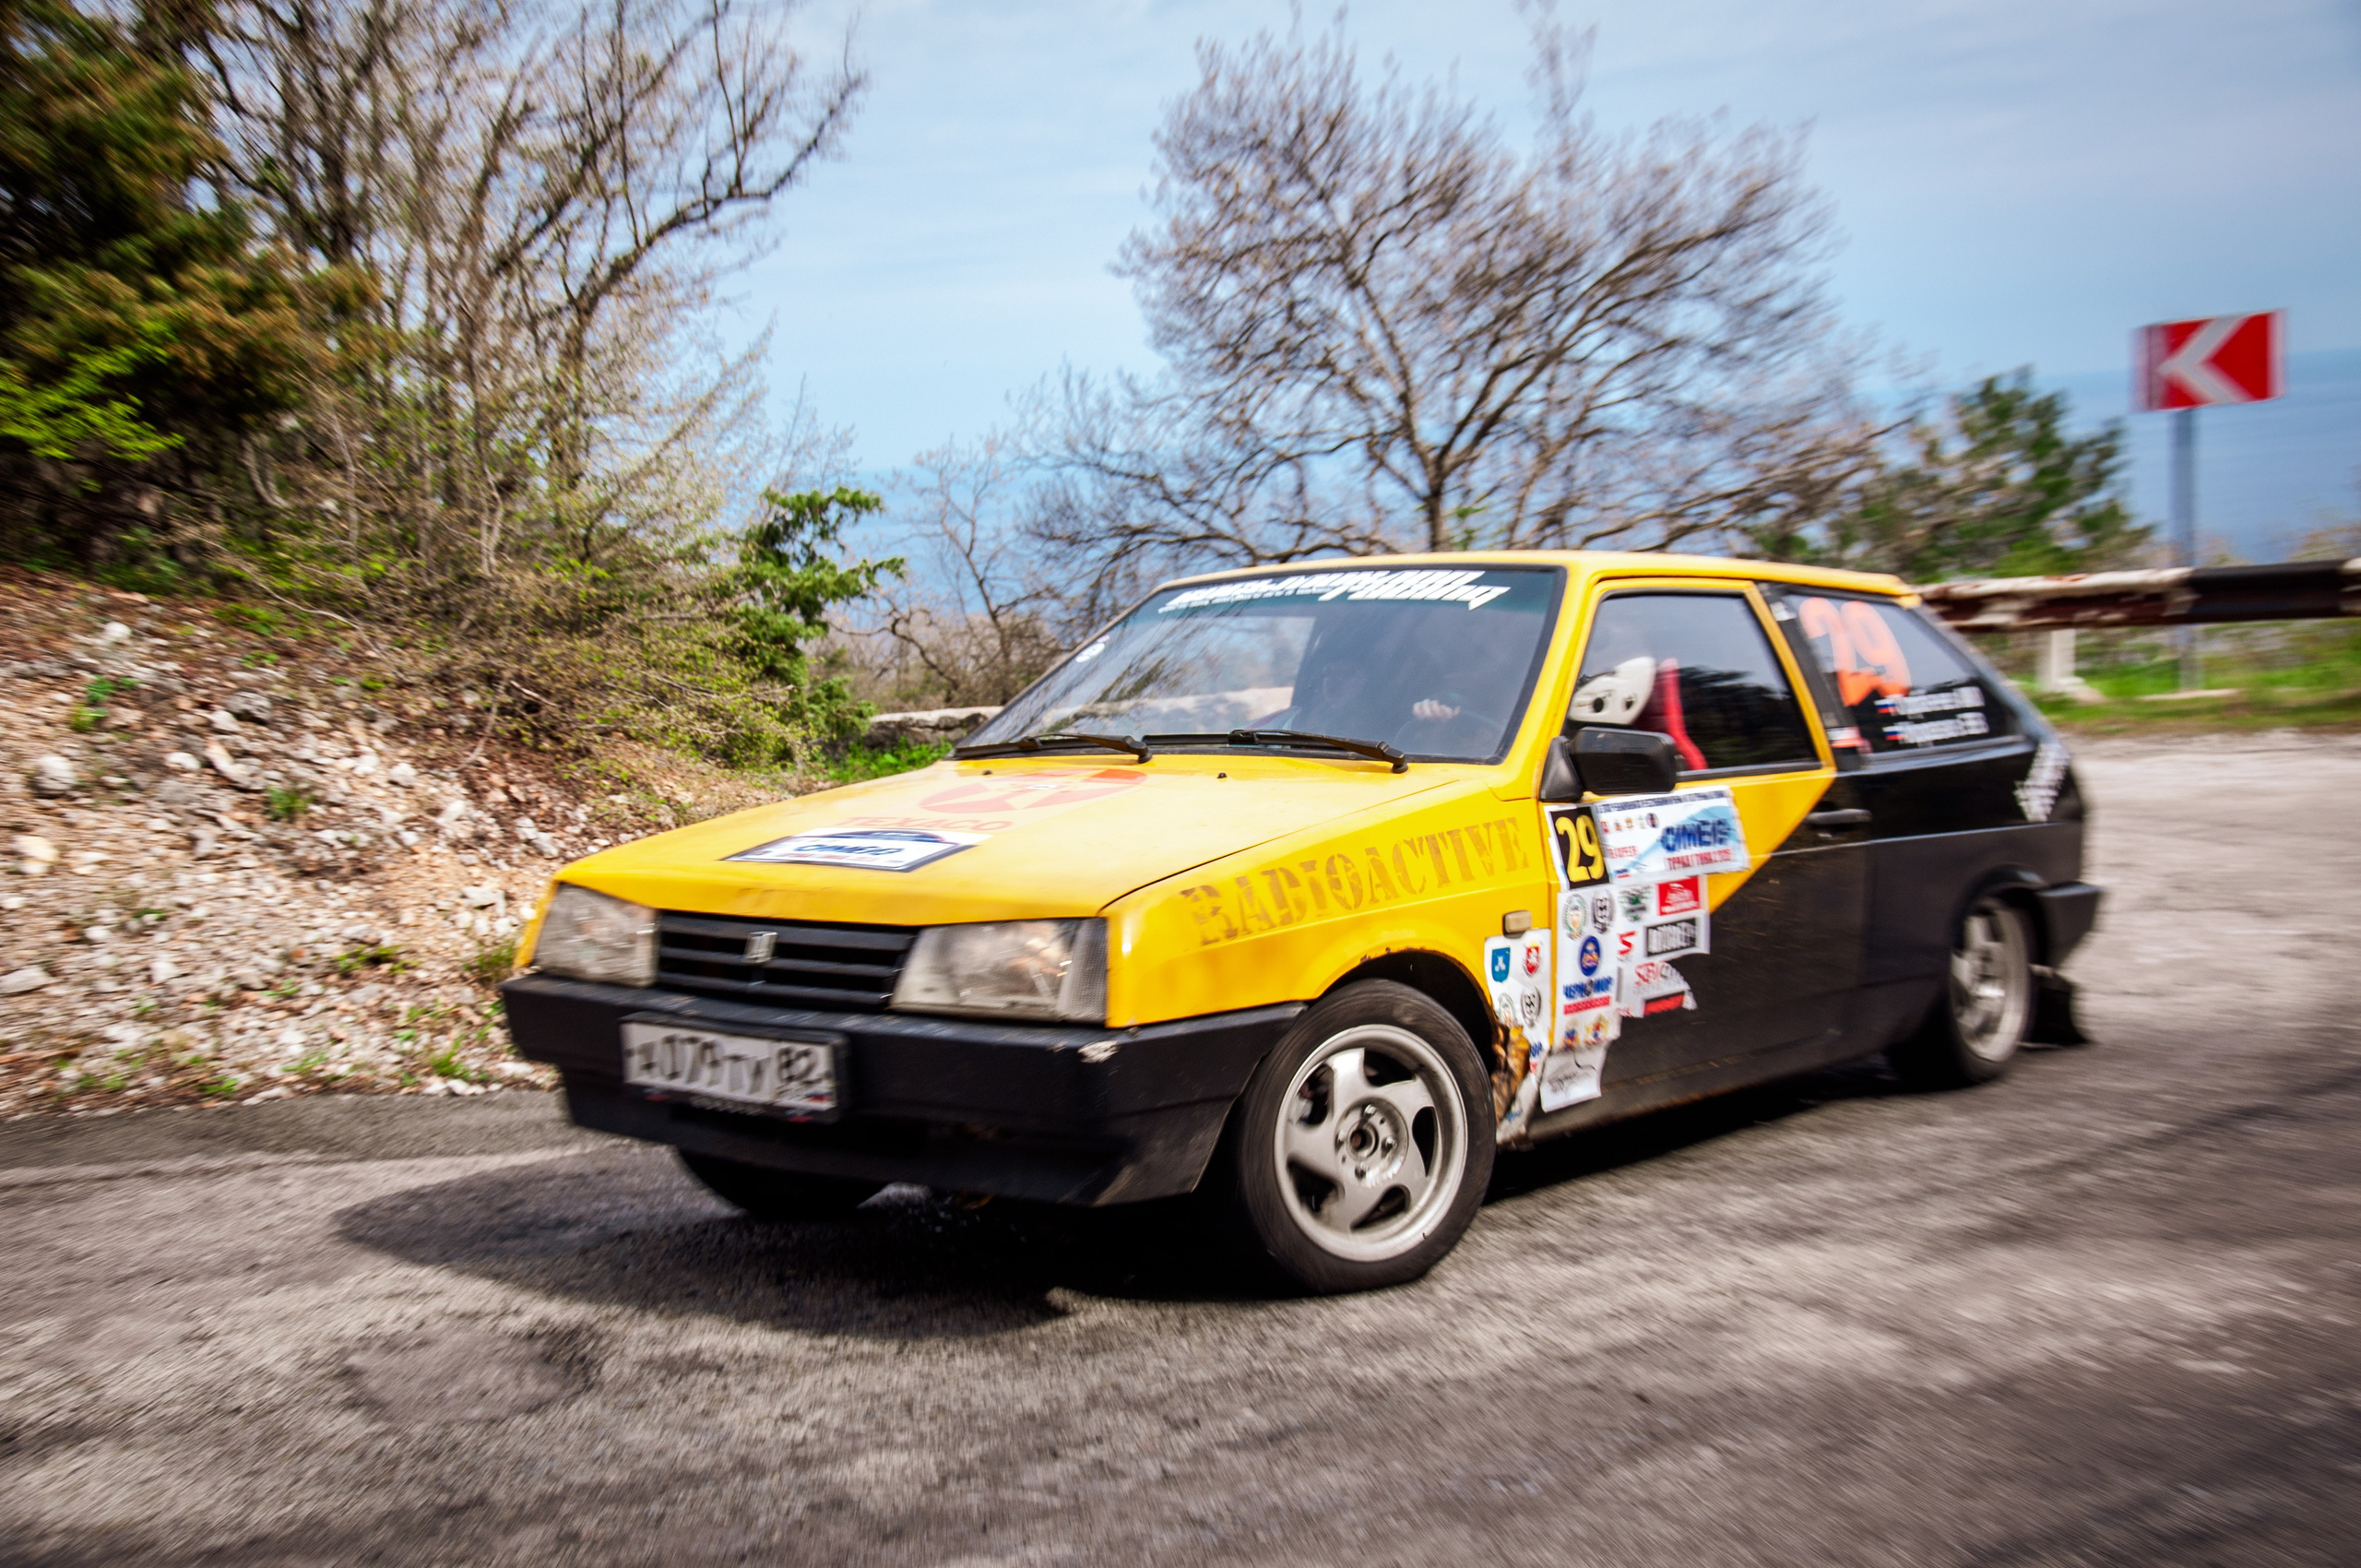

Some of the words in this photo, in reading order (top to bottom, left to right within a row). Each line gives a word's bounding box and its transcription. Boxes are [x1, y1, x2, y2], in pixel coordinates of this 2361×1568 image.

[1799, 597, 1912, 707] 29
[835, 816, 1014, 831] TEXACO
[1556, 814, 1607, 884] 29
[1180, 816, 1531, 946] RADIOACTIVE
